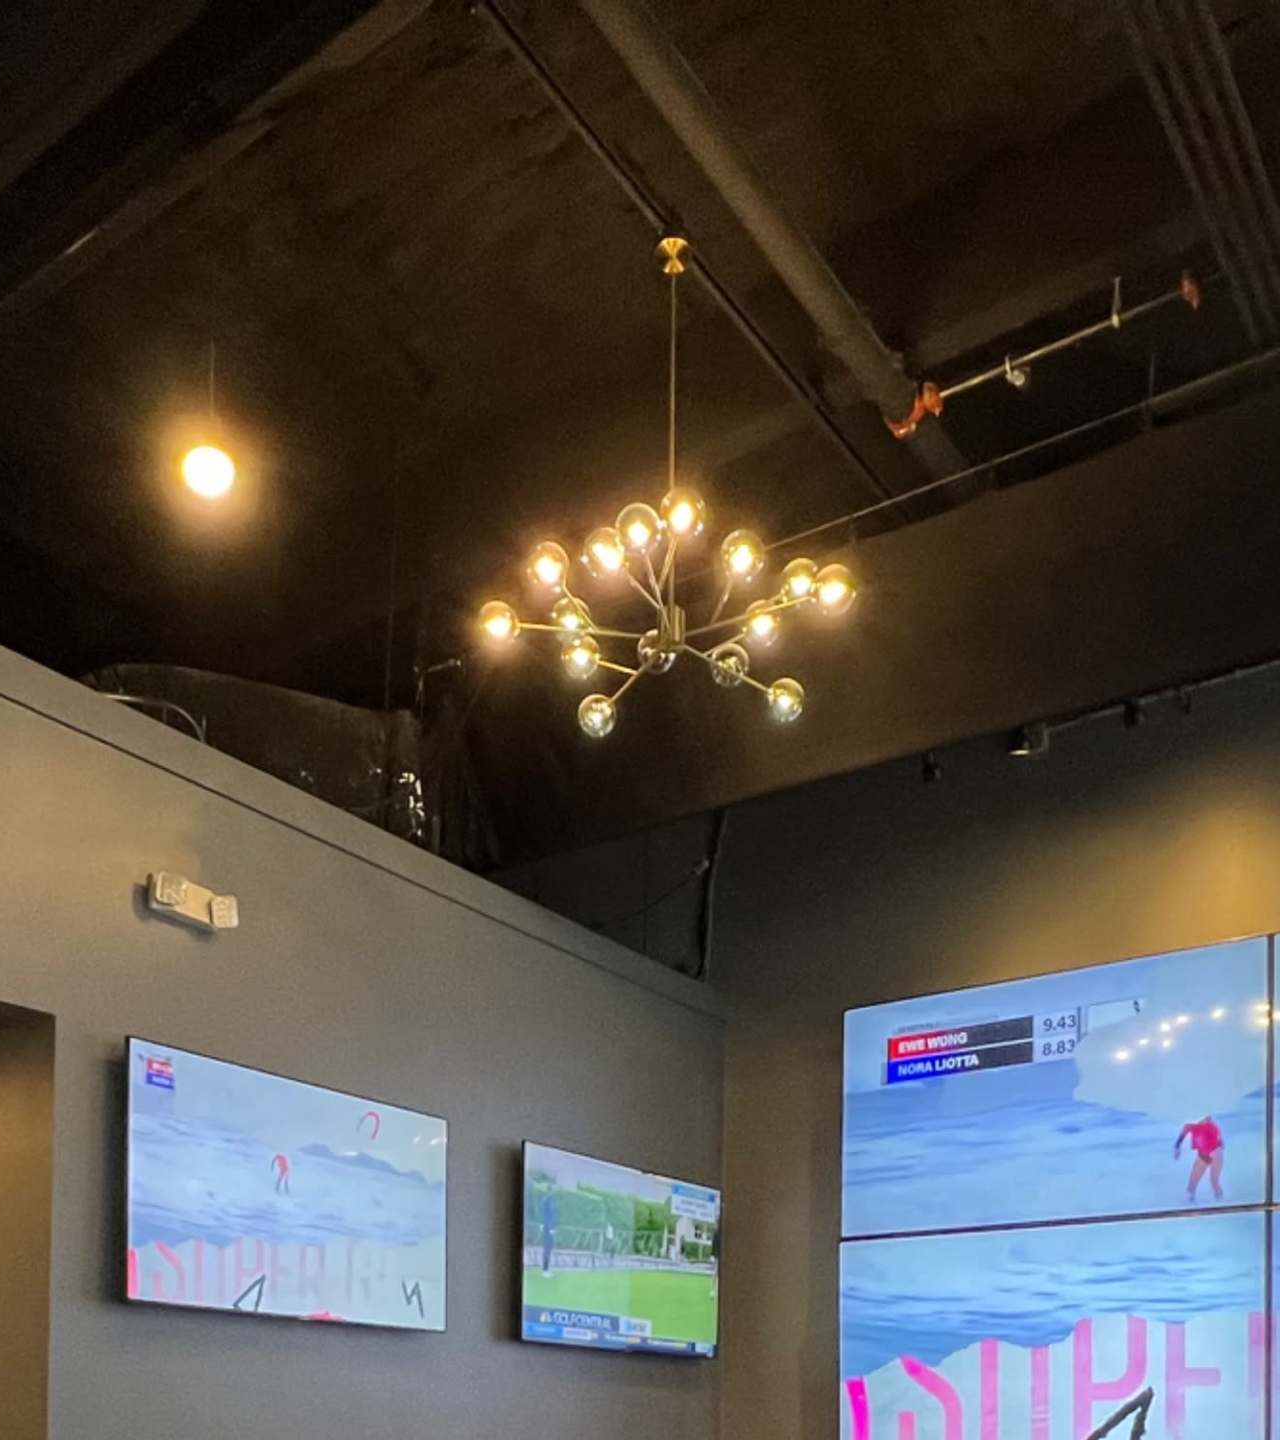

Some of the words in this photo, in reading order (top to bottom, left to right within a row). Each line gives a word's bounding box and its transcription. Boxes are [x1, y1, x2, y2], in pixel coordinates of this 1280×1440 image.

[926, 1032, 968, 1052] WONG
[1042, 1014, 1077, 1032] 9.43
[897, 1061, 932, 1077] NORA
[934, 1053, 980, 1072] LIOTTA
[1041, 1038, 1075, 1056] 8.83
